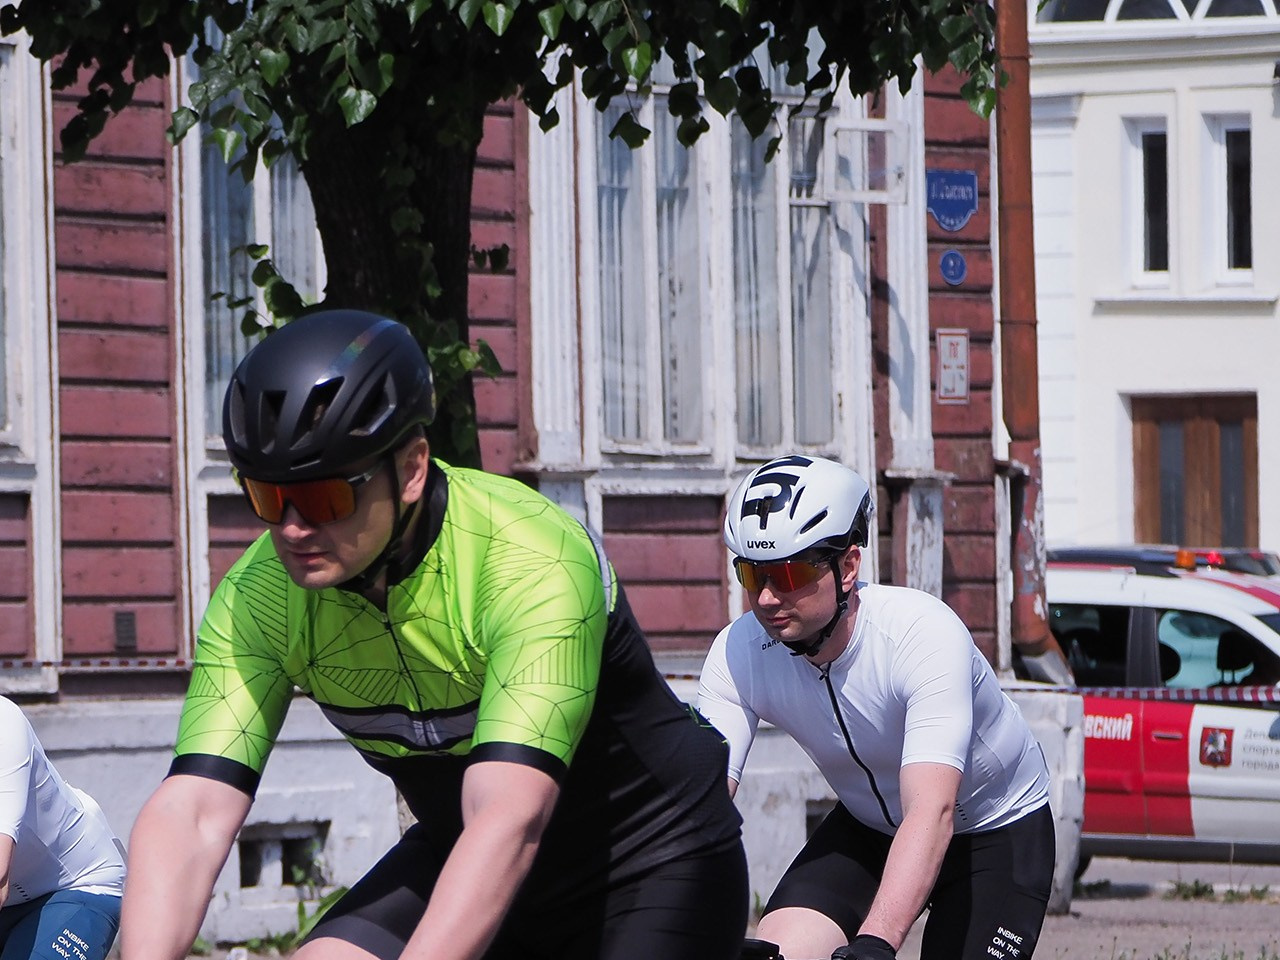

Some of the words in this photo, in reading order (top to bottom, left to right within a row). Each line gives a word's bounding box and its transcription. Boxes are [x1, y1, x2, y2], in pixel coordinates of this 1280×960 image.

[746, 540, 776, 549] uvex
[57, 935, 72, 949] ON
[62, 928, 90, 952] INBIKE
[997, 926, 1023, 945] INBIKE
[992, 936, 1006, 948] ON
[1006, 943, 1020, 958] THE
